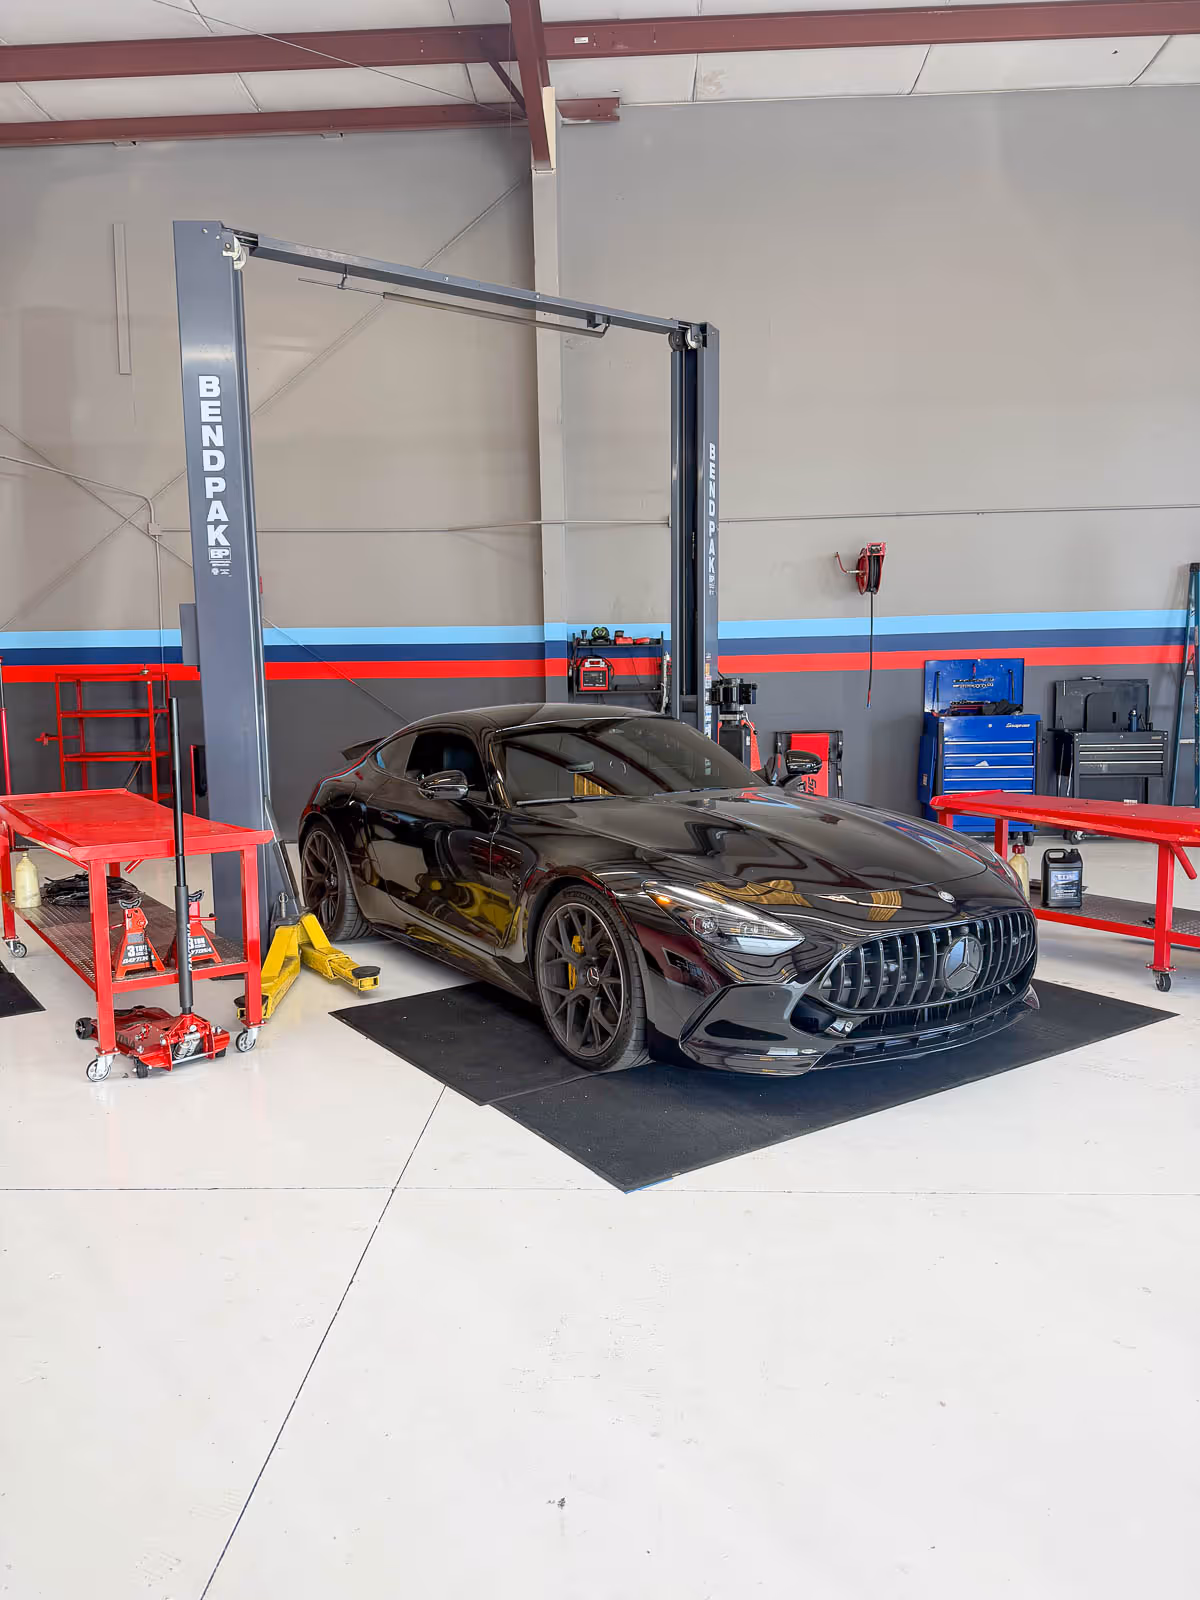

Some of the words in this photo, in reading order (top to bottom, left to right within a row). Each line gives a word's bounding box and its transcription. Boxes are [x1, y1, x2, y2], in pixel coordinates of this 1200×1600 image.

[198, 375, 231, 546] BENDPAK
[708, 442, 716, 574] BENDPAK
[126, 945, 136, 957] 3
